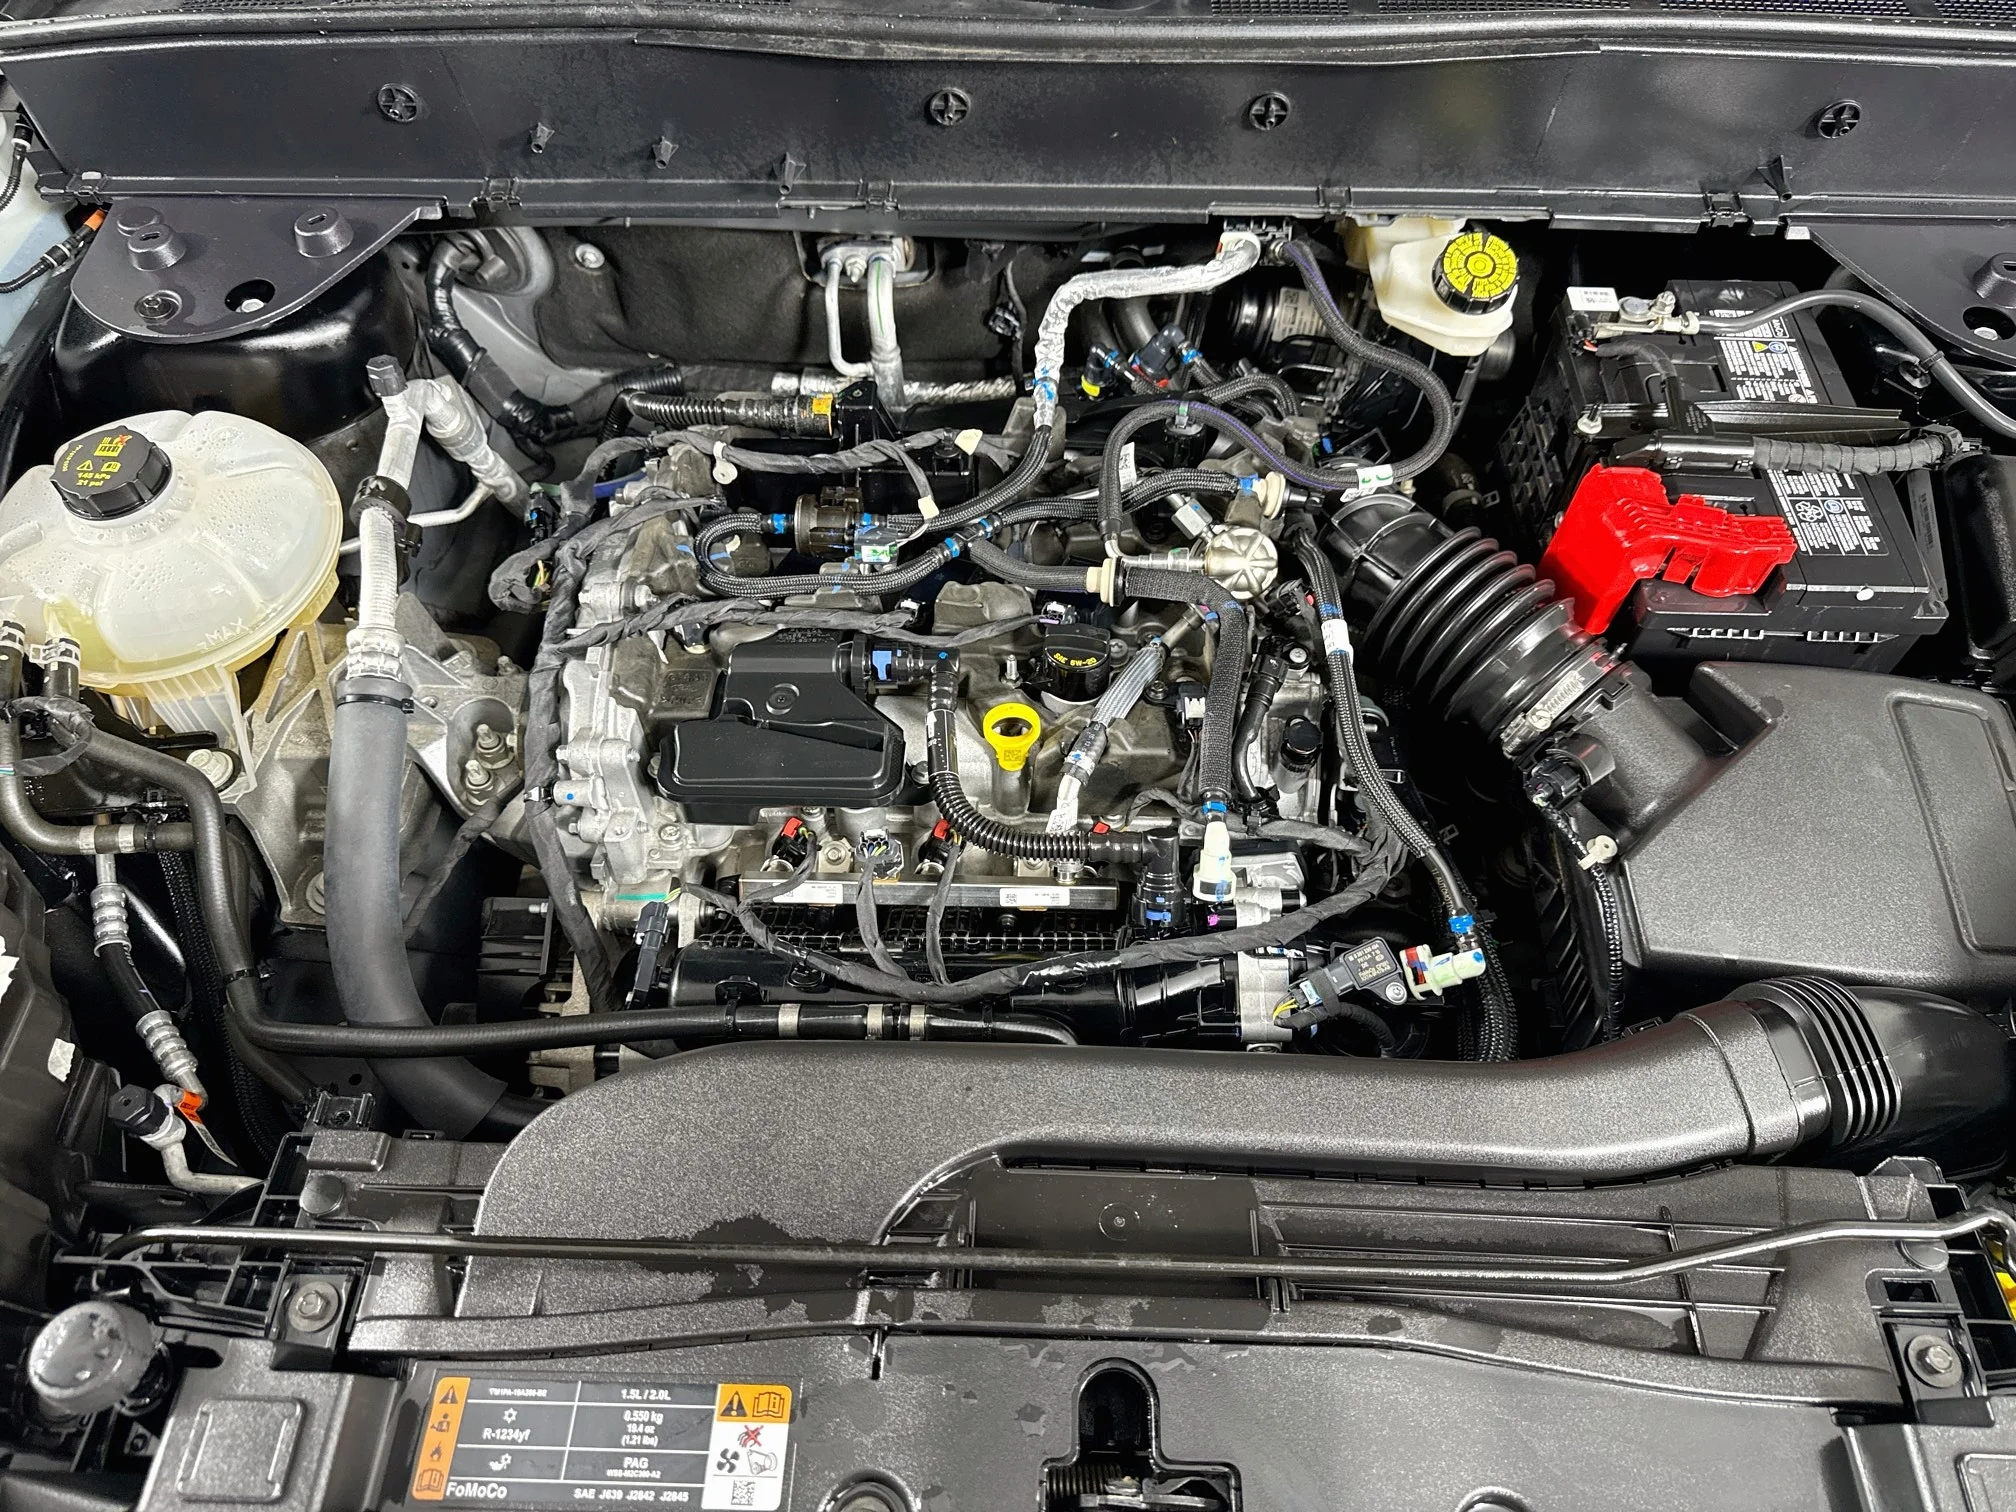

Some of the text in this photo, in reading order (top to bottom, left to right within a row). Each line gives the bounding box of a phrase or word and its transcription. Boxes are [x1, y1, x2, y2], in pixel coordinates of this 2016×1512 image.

[204, 616, 250, 647] MAX
[1053, 652, 1068, 664] SAE
[621, 1388, 642, 1400] 1.5L
[649, 1389, 671, 1401] 2.0L
[623, 1410, 663, 1425] 0.550 kg
[482, 1427, 531, 1443] R-1234yf
[627, 1423, 655, 1434] 19.4 oz
[623, 1457, 649, 1469] PAG
[446, 1482, 507, 1499] FoMoCo
[573, 1488, 689, 1502] SAE J639 J2842 J2845
